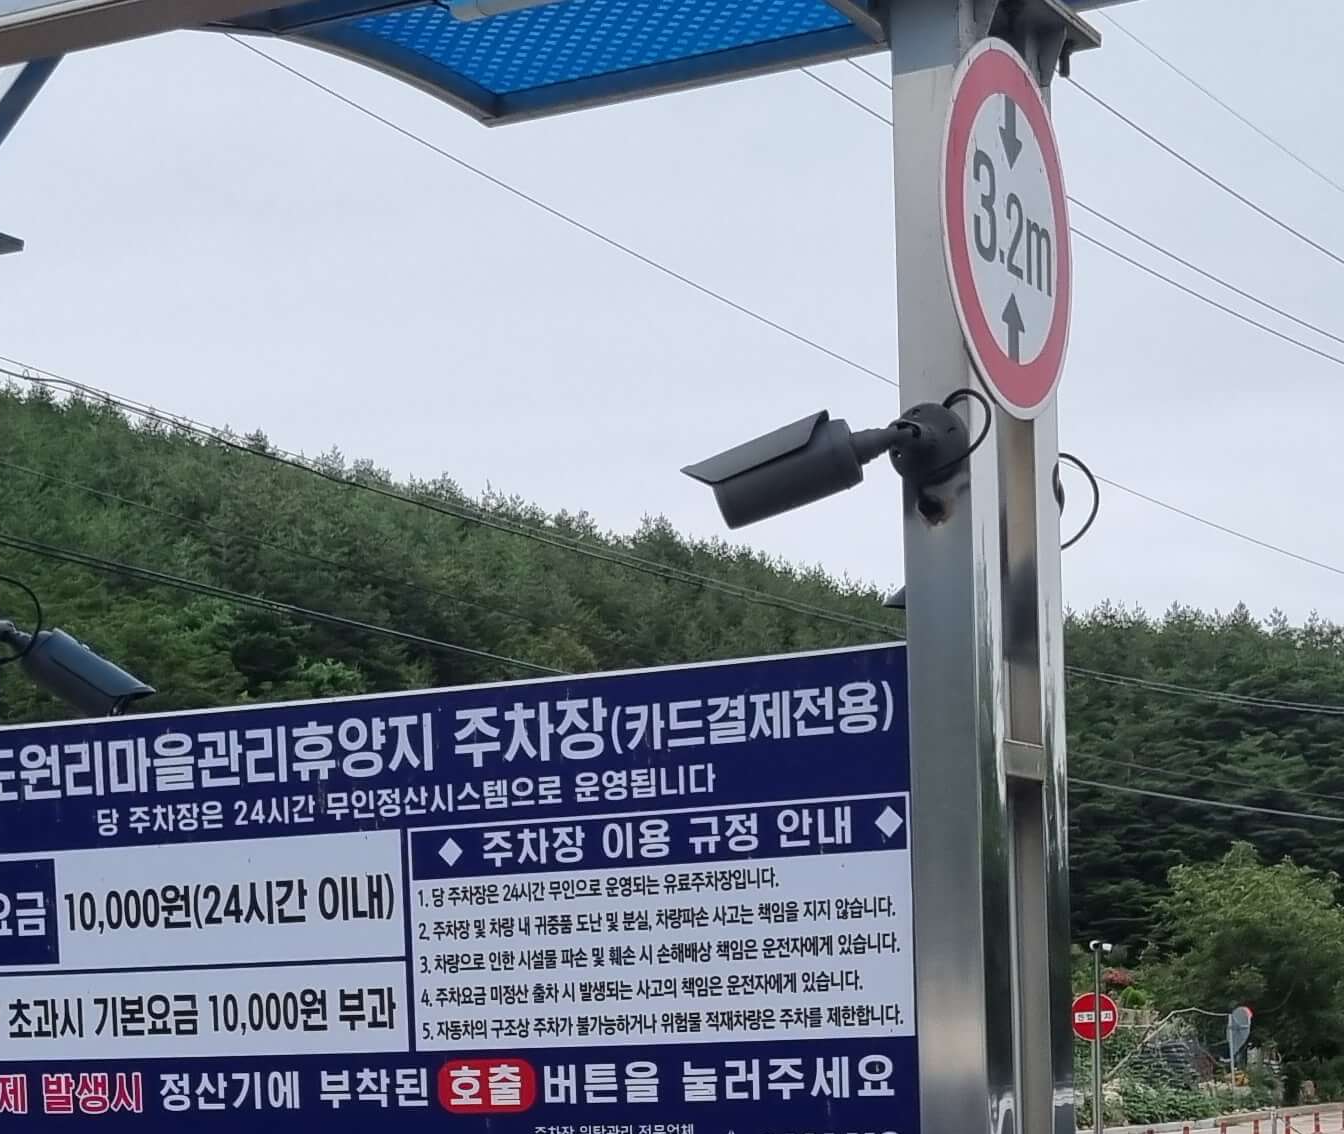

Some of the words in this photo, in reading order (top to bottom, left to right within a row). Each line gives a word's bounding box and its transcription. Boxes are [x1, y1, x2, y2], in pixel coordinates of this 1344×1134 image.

[972, 148, 1053, 297] 3.2m
[454, 696, 607, 768] 주차장
[611, 679, 895, 755] (카드결제전용)
[98, 810, 119, 836] 당
[130, 801, 224, 834] 주차장은
[235, 796, 315, 825] 24시간
[326, 776, 563, 822] 무인정산시스템으로
[574, 763, 716, 802] 운영됩니다
[482, 825, 585, 867] 주차장
[603, 818, 670, 860] 이용
[689, 811, 759, 854] 규정
[777, 806, 852, 848] 안내
[65, 879, 308, 934] 10,000원(24시간
[319, 873, 393, 921] 이내)
[418, 889, 428, 908] 1.
[432, 888, 445, 907] 당
[448, 884, 499, 906] 주차장은
[503, 881, 545, 902] 24시간
[548, 879, 602, 900] 무인으로
[606, 876, 659, 898] 운영되는
[664, 867, 779, 894] 유료주차장입니다.
[418, 923, 430, 941] 2.
[433, 919, 470, 941] 주차장
[474, 918, 486, 938] 및
[490, 917, 514, 937] 차량
[519, 917, 530, 936] 내
[534, 915, 573, 936] 귀중품
[576, 913, 602, 933] 도난
[606, 912, 618, 932] 및
[622, 910, 652, 931] 분실,
[657, 906, 709, 929] 차량파손
[712, 904, 754, 926] 사고는
[758, 901, 799, 923] 책임을
[803, 899, 830, 920] 지지
[835, 896, 896, 919] 않습니다.
[420, 956, 431, 974] 3.
[434, 953, 485, 974] 차량으로
[489, 951, 514, 971] 인한
[519, 949, 557, 970] 시설물
[561, 948, 588, 968] 파손
[592, 947, 604, 966] 및
[609, 946, 636, 966] 훼손
[640, 945, 653, 964] 시
[657, 942, 712, 964] 손해배상
[716, 939, 757, 960] 책임은
[762, 935, 833, 958] 운전자에게
[838, 932, 900, 955] 있습니다.
[8, 997, 85, 1039] 초과시
[95, 993, 198, 1037] 기본요금
[210, 988, 328, 1034] 10,000원
[339, 986, 396, 1031] 부과
[421, 990, 432, 1007] 4.
[436, 986, 486, 1007] 주차요금
[490, 984, 528, 1005] 미정산
[532, 983, 558, 1003] 출차
[562, 982, 575, 1002] 시
[579, 980, 632, 1001] 발생되는
[635, 977, 677, 999] 사고의
[682, 976, 723, 998] 책임은
[727, 972, 797, 994] 운전자에게
[802, 970, 863, 992] 있습니다.
[422, 1023, 433, 1040] 5.
[437, 1019, 487, 1040] 자동차의
[491, 1018, 529, 1038] 구조상
[534, 1016, 573, 1037] 주차가
[576, 1013, 657, 1036] 불가능하거나
[661, 1011, 701, 1033] 위험물
[706, 1008, 775, 1031] 적재차량은
[780, 1006, 823, 1028] 주차를
[827, 1004, 903, 1027] 제한합니다.
[1078, 1013, 1111, 1021] 진입지
[42, 1072, 143, 1114] 발생시
[160, 1070, 301, 1111] 정산기에
[320, 1066, 429, 1108] 부착된
[449, 1065, 522, 1107] 호출
[544, 1061, 660, 1105] 버튼을
[682, 1054, 896, 1103] 눌러주세요
